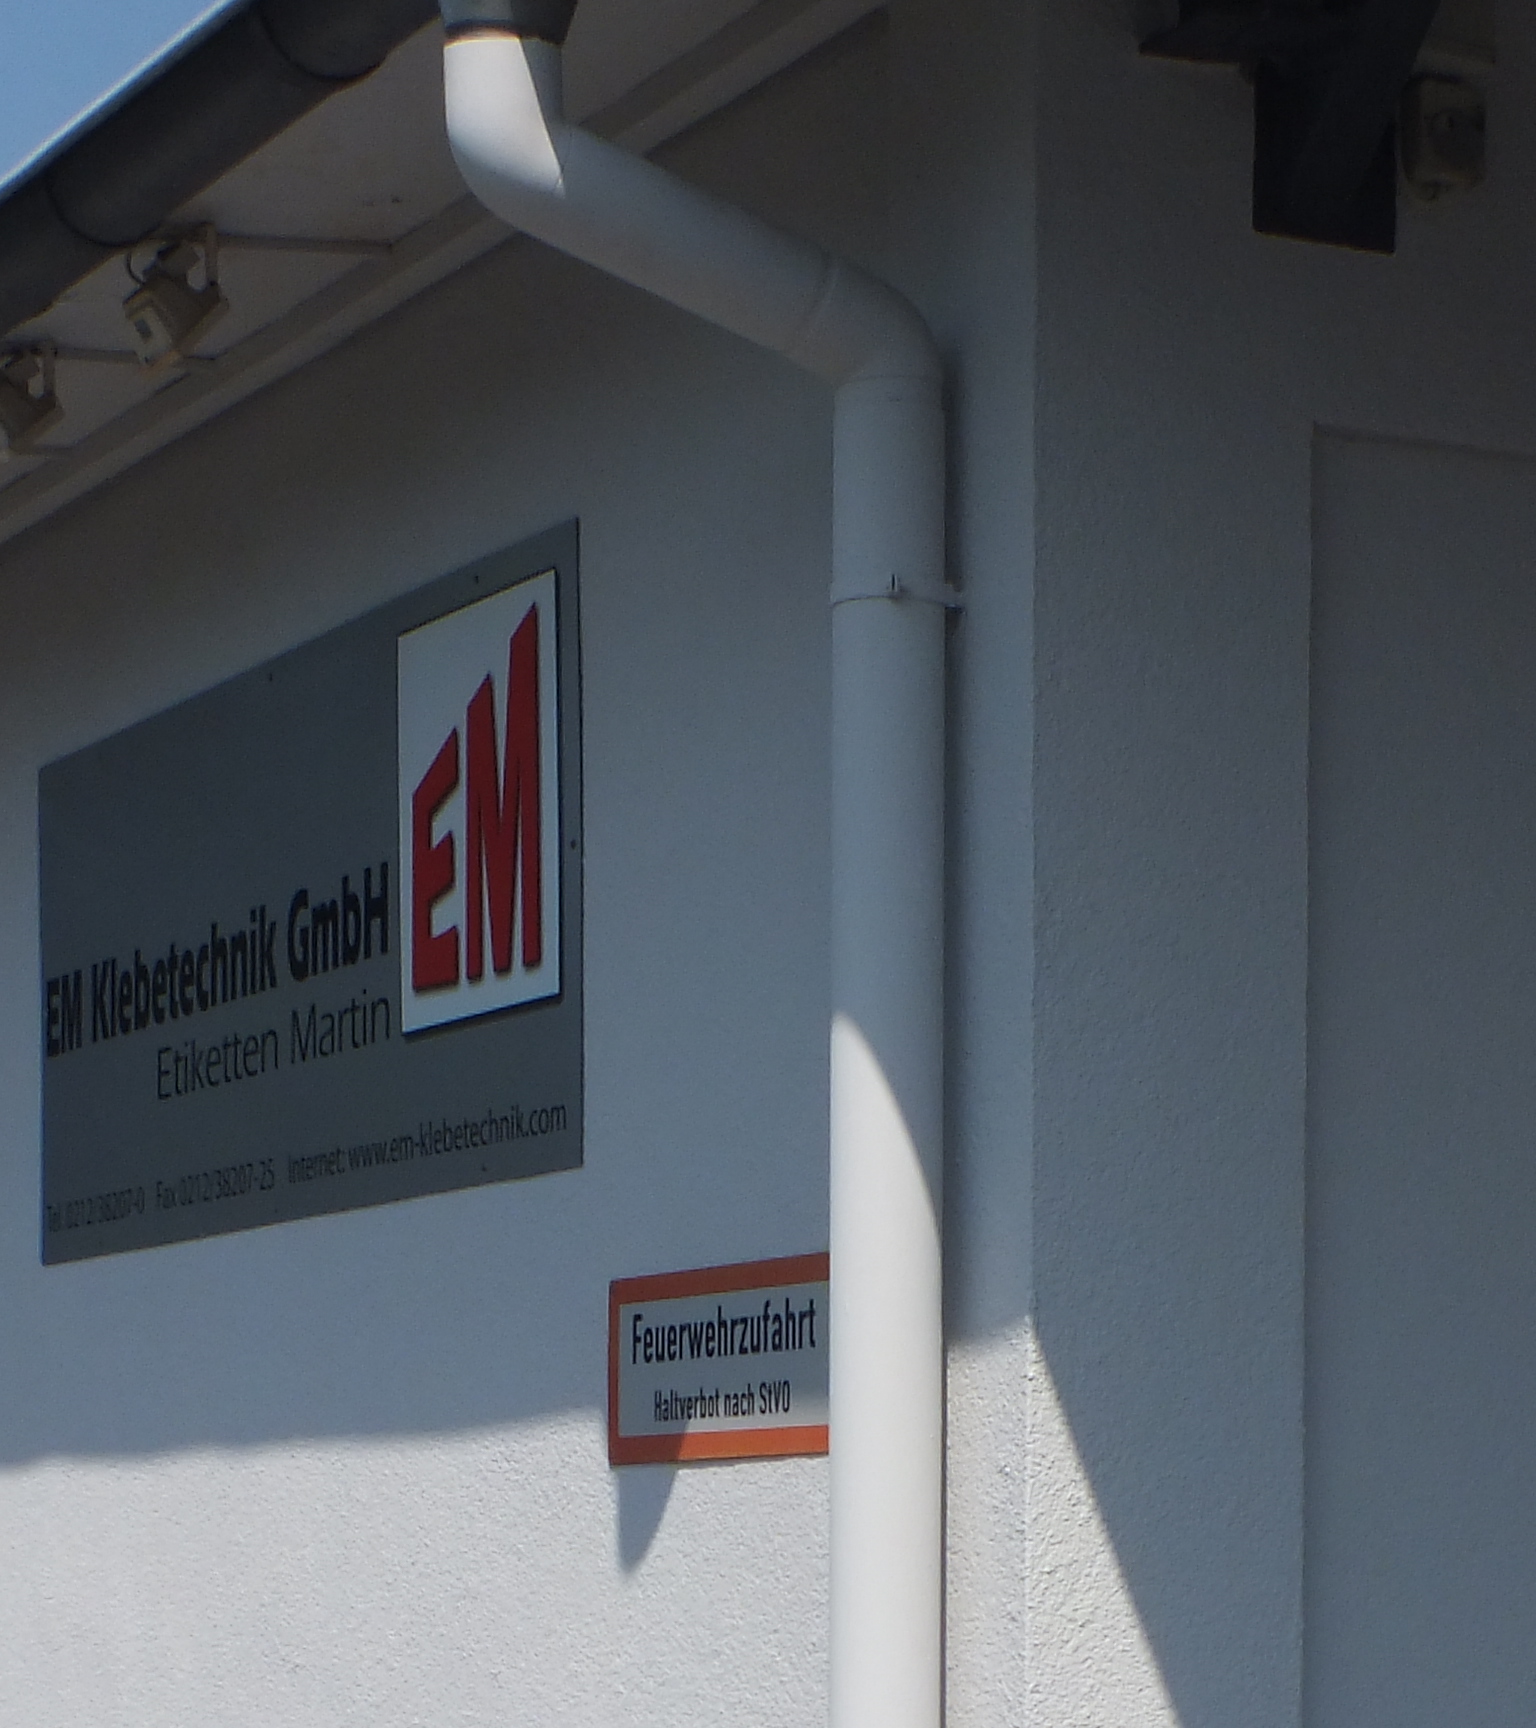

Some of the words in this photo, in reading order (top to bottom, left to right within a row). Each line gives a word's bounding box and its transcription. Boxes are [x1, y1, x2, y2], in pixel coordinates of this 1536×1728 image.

[412, 602, 541, 992] EM
[46, 969, 83, 1058] EM
[91, 904, 278, 1043] Klebetechnik
[287, 861, 390, 982] GmbH
[157, 1029, 280, 1101] Etiketten
[290, 988, 391, 1065] Martin
[155, 1180, 176, 1209] Fax
[348, 1103, 567, 1170] www.em-klebetechnik.com
[631, 1297, 817, 1365] Feuerwehrzufahrt
[653, 1385, 720, 1422] Haltverbot
[724, 1383, 755, 1417] nach
[759, 1380, 791, 1414] StVO
